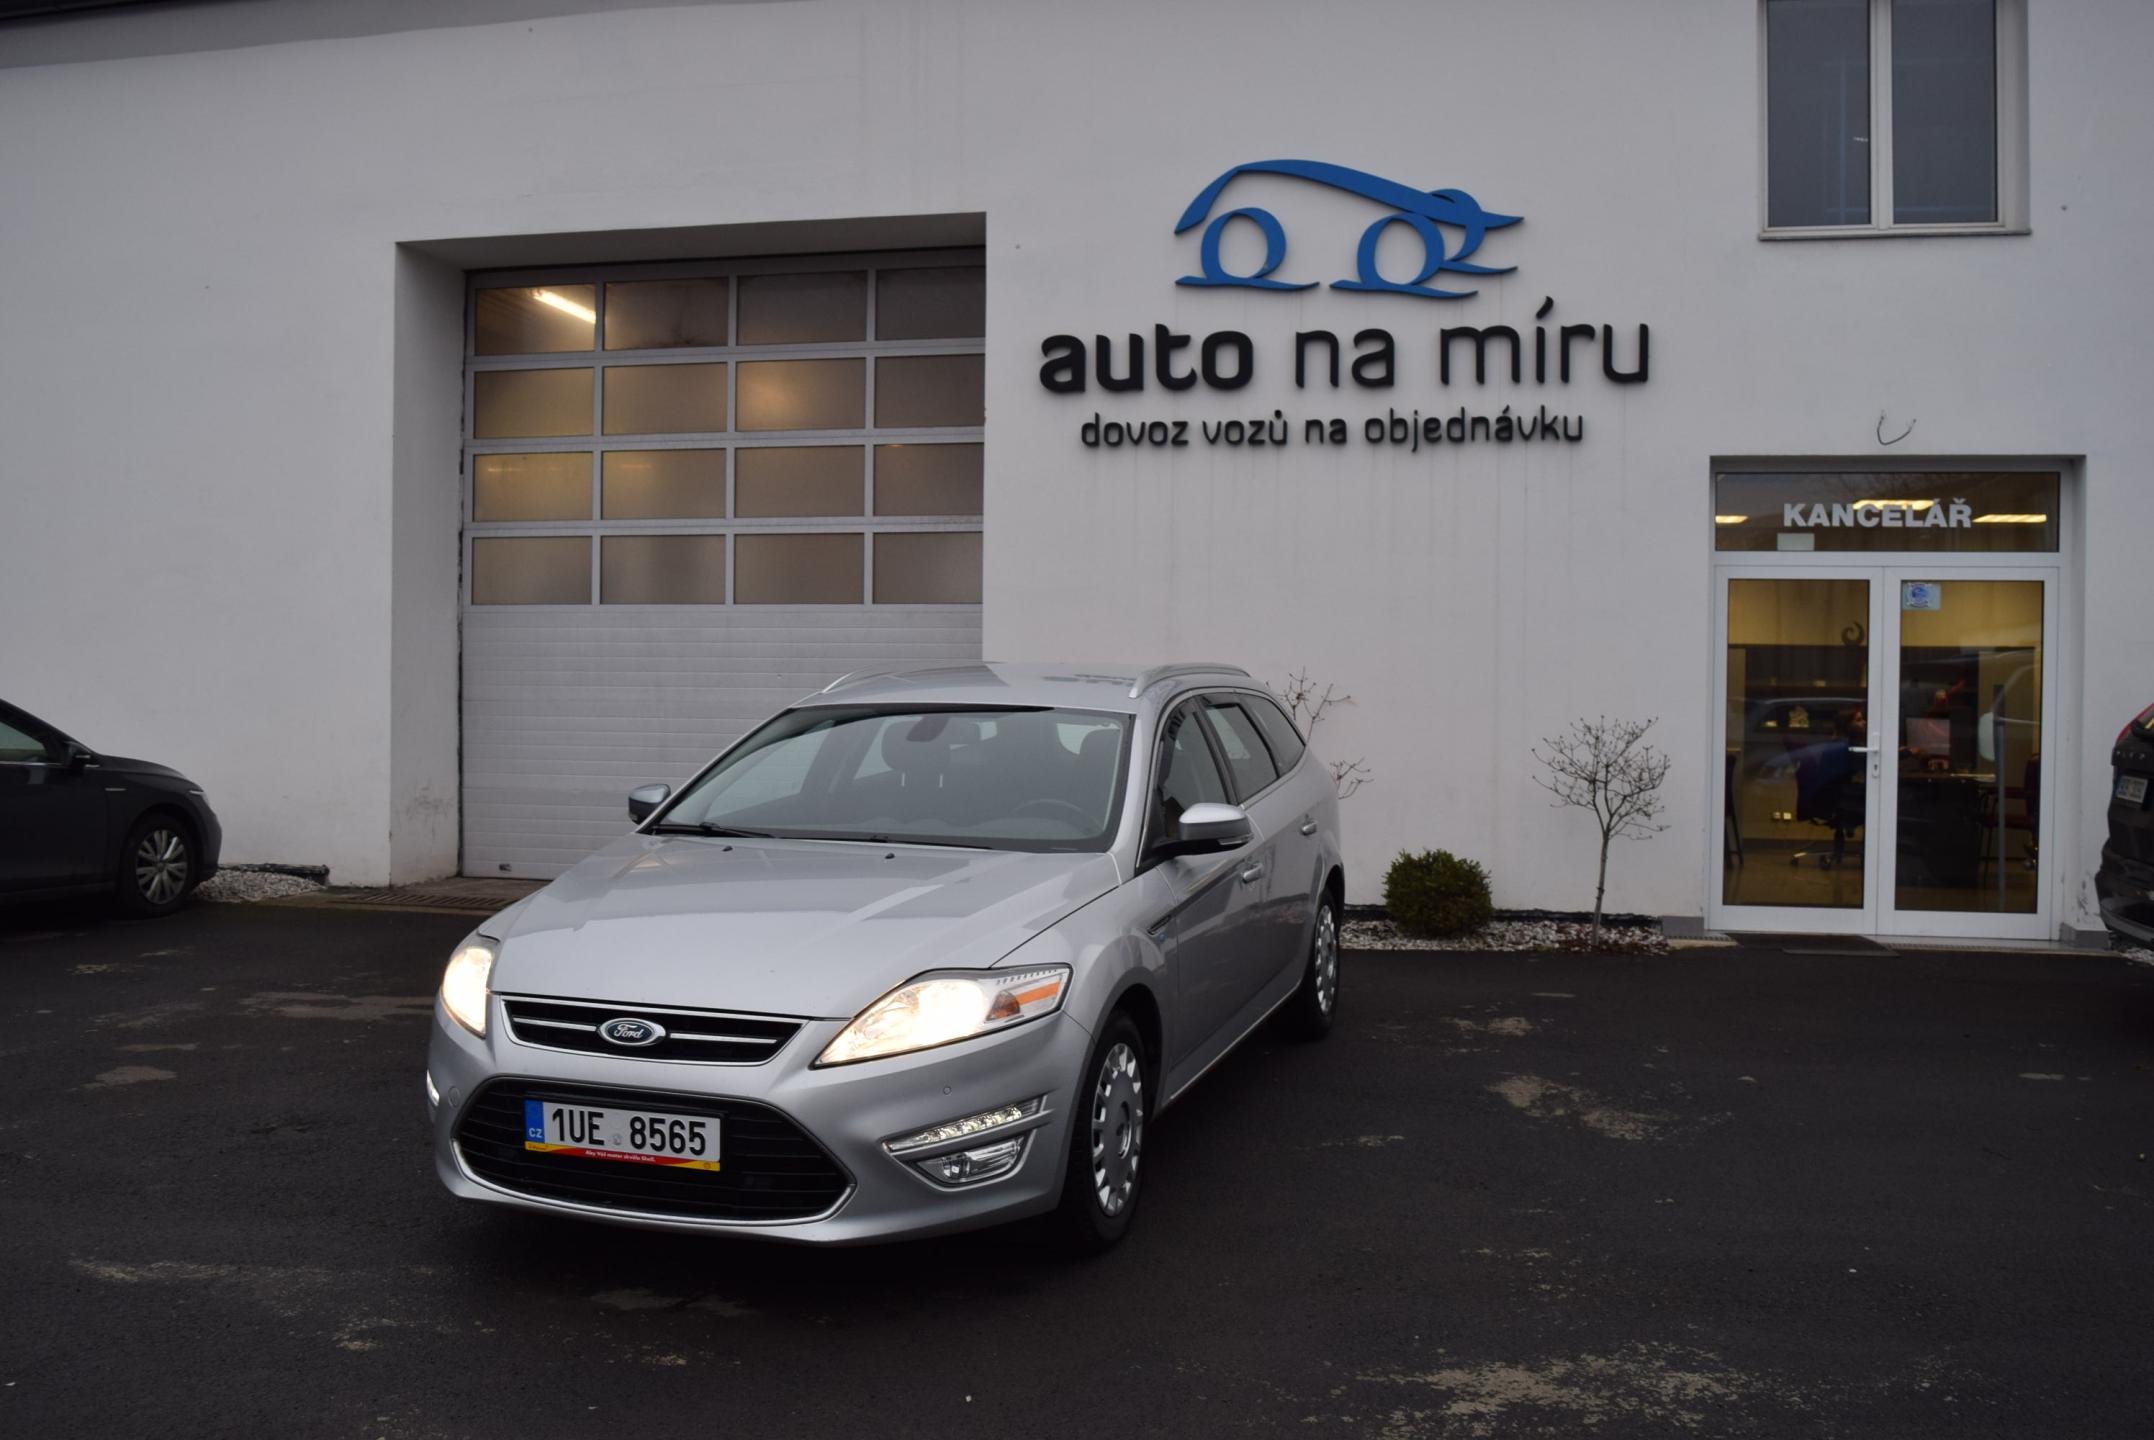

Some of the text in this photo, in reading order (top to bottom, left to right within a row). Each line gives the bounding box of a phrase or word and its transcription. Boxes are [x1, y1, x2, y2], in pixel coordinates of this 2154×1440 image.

[1039, 296, 1650, 396] auto na míru
[1081, 404, 1584, 454] dovoz vozů na objednávku
[1783, 497, 1972, 528] KANCELÁŘ
[613, 1023, 645, 1040] Ford
[528, 1128, 543, 1139] CZ
[552, 1108, 706, 1157] 1UE 8565
